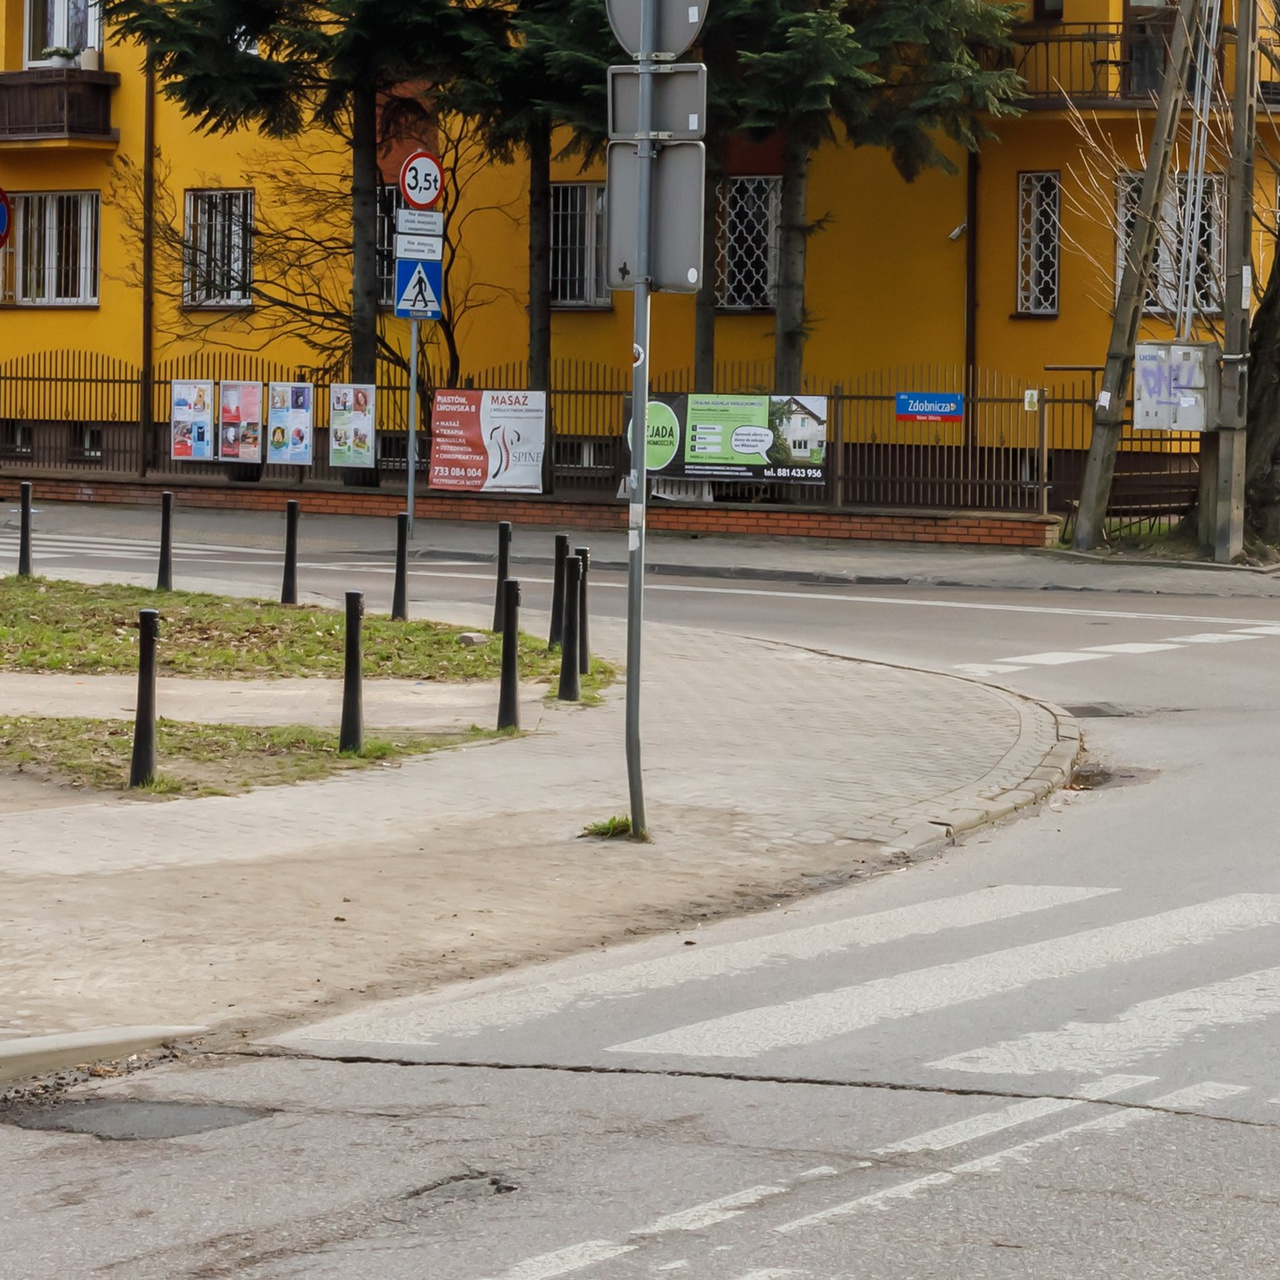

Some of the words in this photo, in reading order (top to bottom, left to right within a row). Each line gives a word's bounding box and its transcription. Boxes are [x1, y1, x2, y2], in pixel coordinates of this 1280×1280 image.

[407, 166, 439, 194] 3,5t
[436, 395, 468, 405] PIASTÓW,
[491, 393, 529, 406] MASAŻ
[436, 404, 470, 412] LWOWSKA
[908, 400, 950, 411] Zdobnicza
[511, 451, 541, 463] SPINE
[434, 466, 449, 476] 733
[450, 467, 466, 477] 084
[466, 467, 482, 477] 004
[764, 468, 776, 477] tel.
[777, 468, 790, 477] 881
[791, 468, 806, 478] 433
[807, 469, 822, 478] 956
